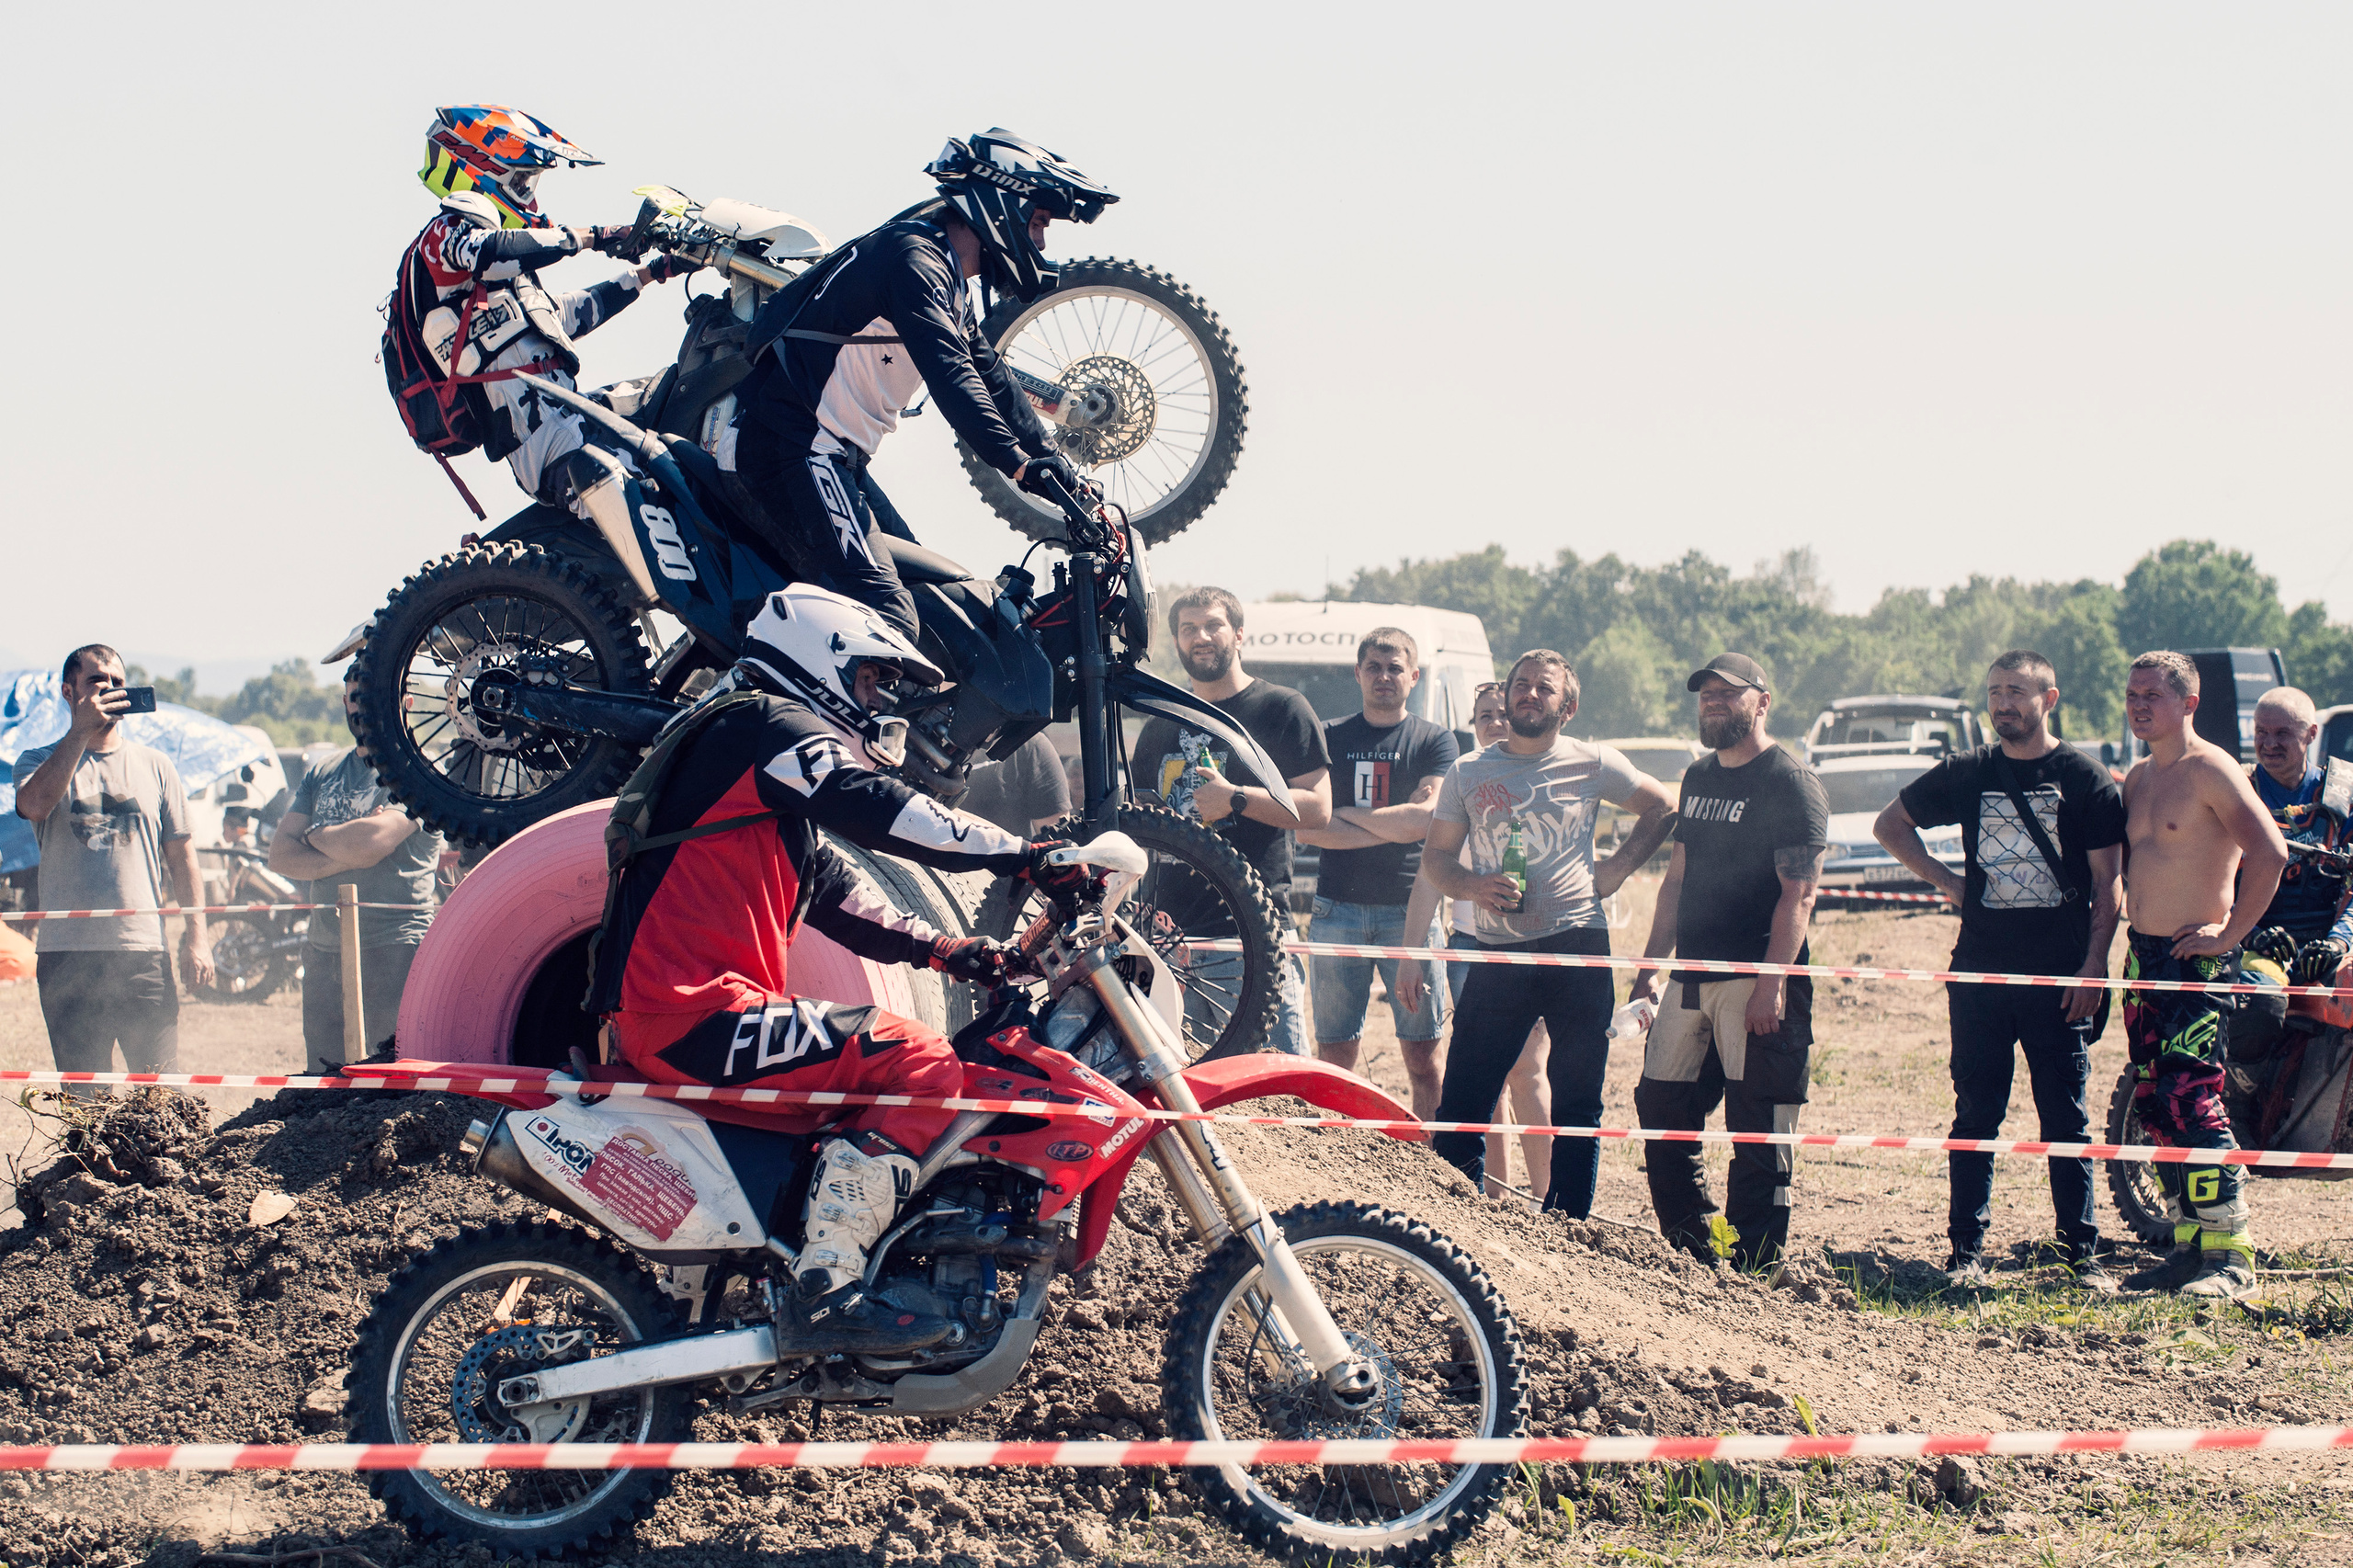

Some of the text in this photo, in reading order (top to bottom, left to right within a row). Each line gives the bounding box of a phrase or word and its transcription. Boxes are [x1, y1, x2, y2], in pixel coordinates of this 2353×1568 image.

[510, 134, 529, 145] Airoh
[432, 131, 509, 176] FMF
[639, 504, 696, 581] 800
[1241, 631, 1362, 646] МОТОСП
[1347, 751, 1401, 760] HILFIGER
[1359, 773, 1385, 801] H
[723, 1000, 835, 1076] FOX
[1100, 1117, 1145, 1159] MOTUL
[543, 1151, 560, 1168] 00%
[610, 1137, 651, 1164] ДОСТАВКА
[1052, 1144, 1088, 1156] ITP
[597, 1171, 611, 1183] При
[599, 1161, 616, 1176] ГПС
[2187, 1168, 2220, 1202] G
